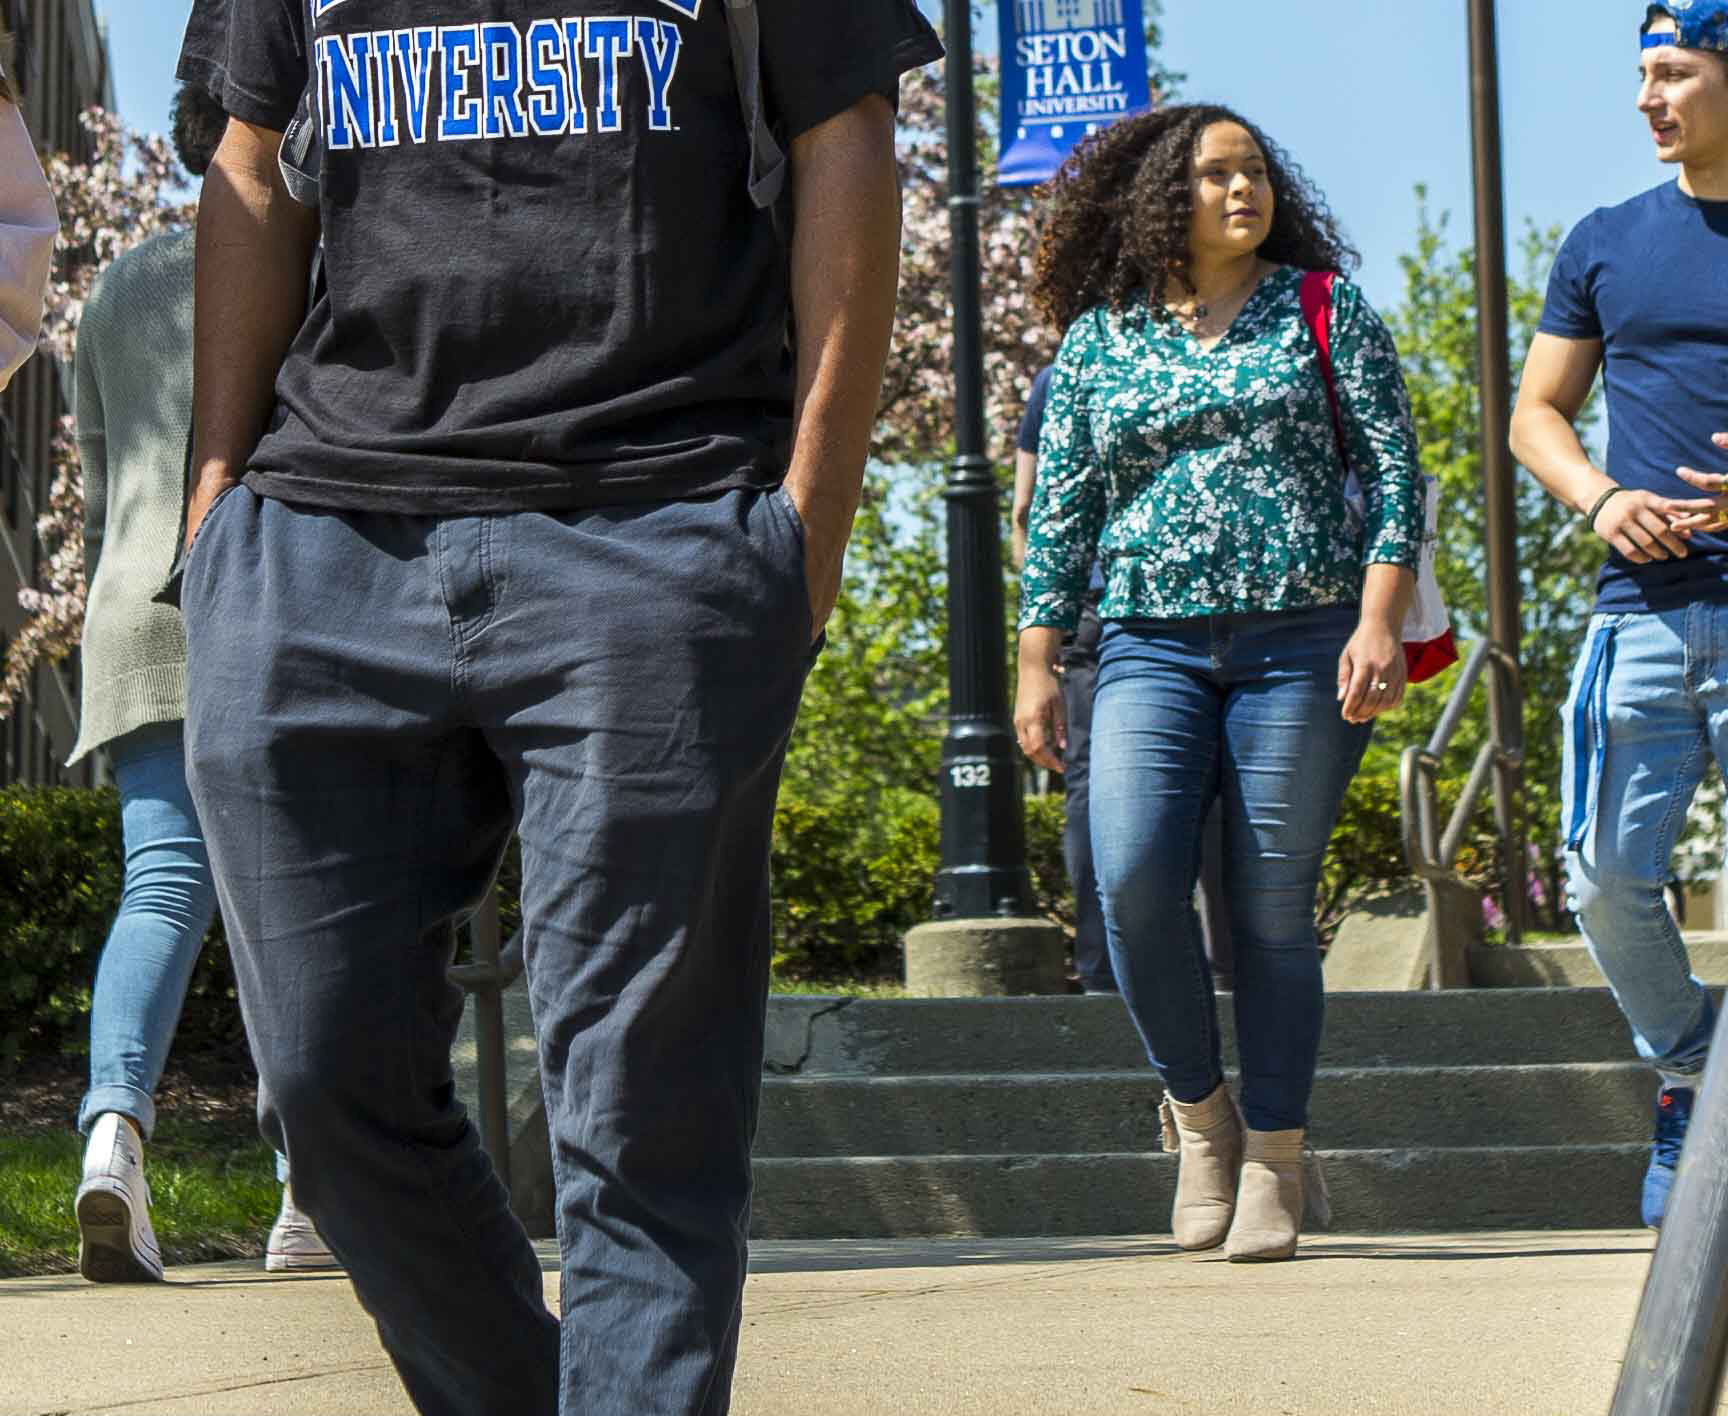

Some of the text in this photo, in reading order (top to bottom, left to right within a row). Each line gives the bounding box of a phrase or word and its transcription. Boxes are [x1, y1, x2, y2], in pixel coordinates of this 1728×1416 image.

[1016, 28, 1127, 67] SETON
[315, 15, 684, 150] NIVERSITY
[1026, 61, 1123, 98] HALL
[1017, 92, 1129, 117] UNIVERSITY
[950, 764, 992, 788] 132
